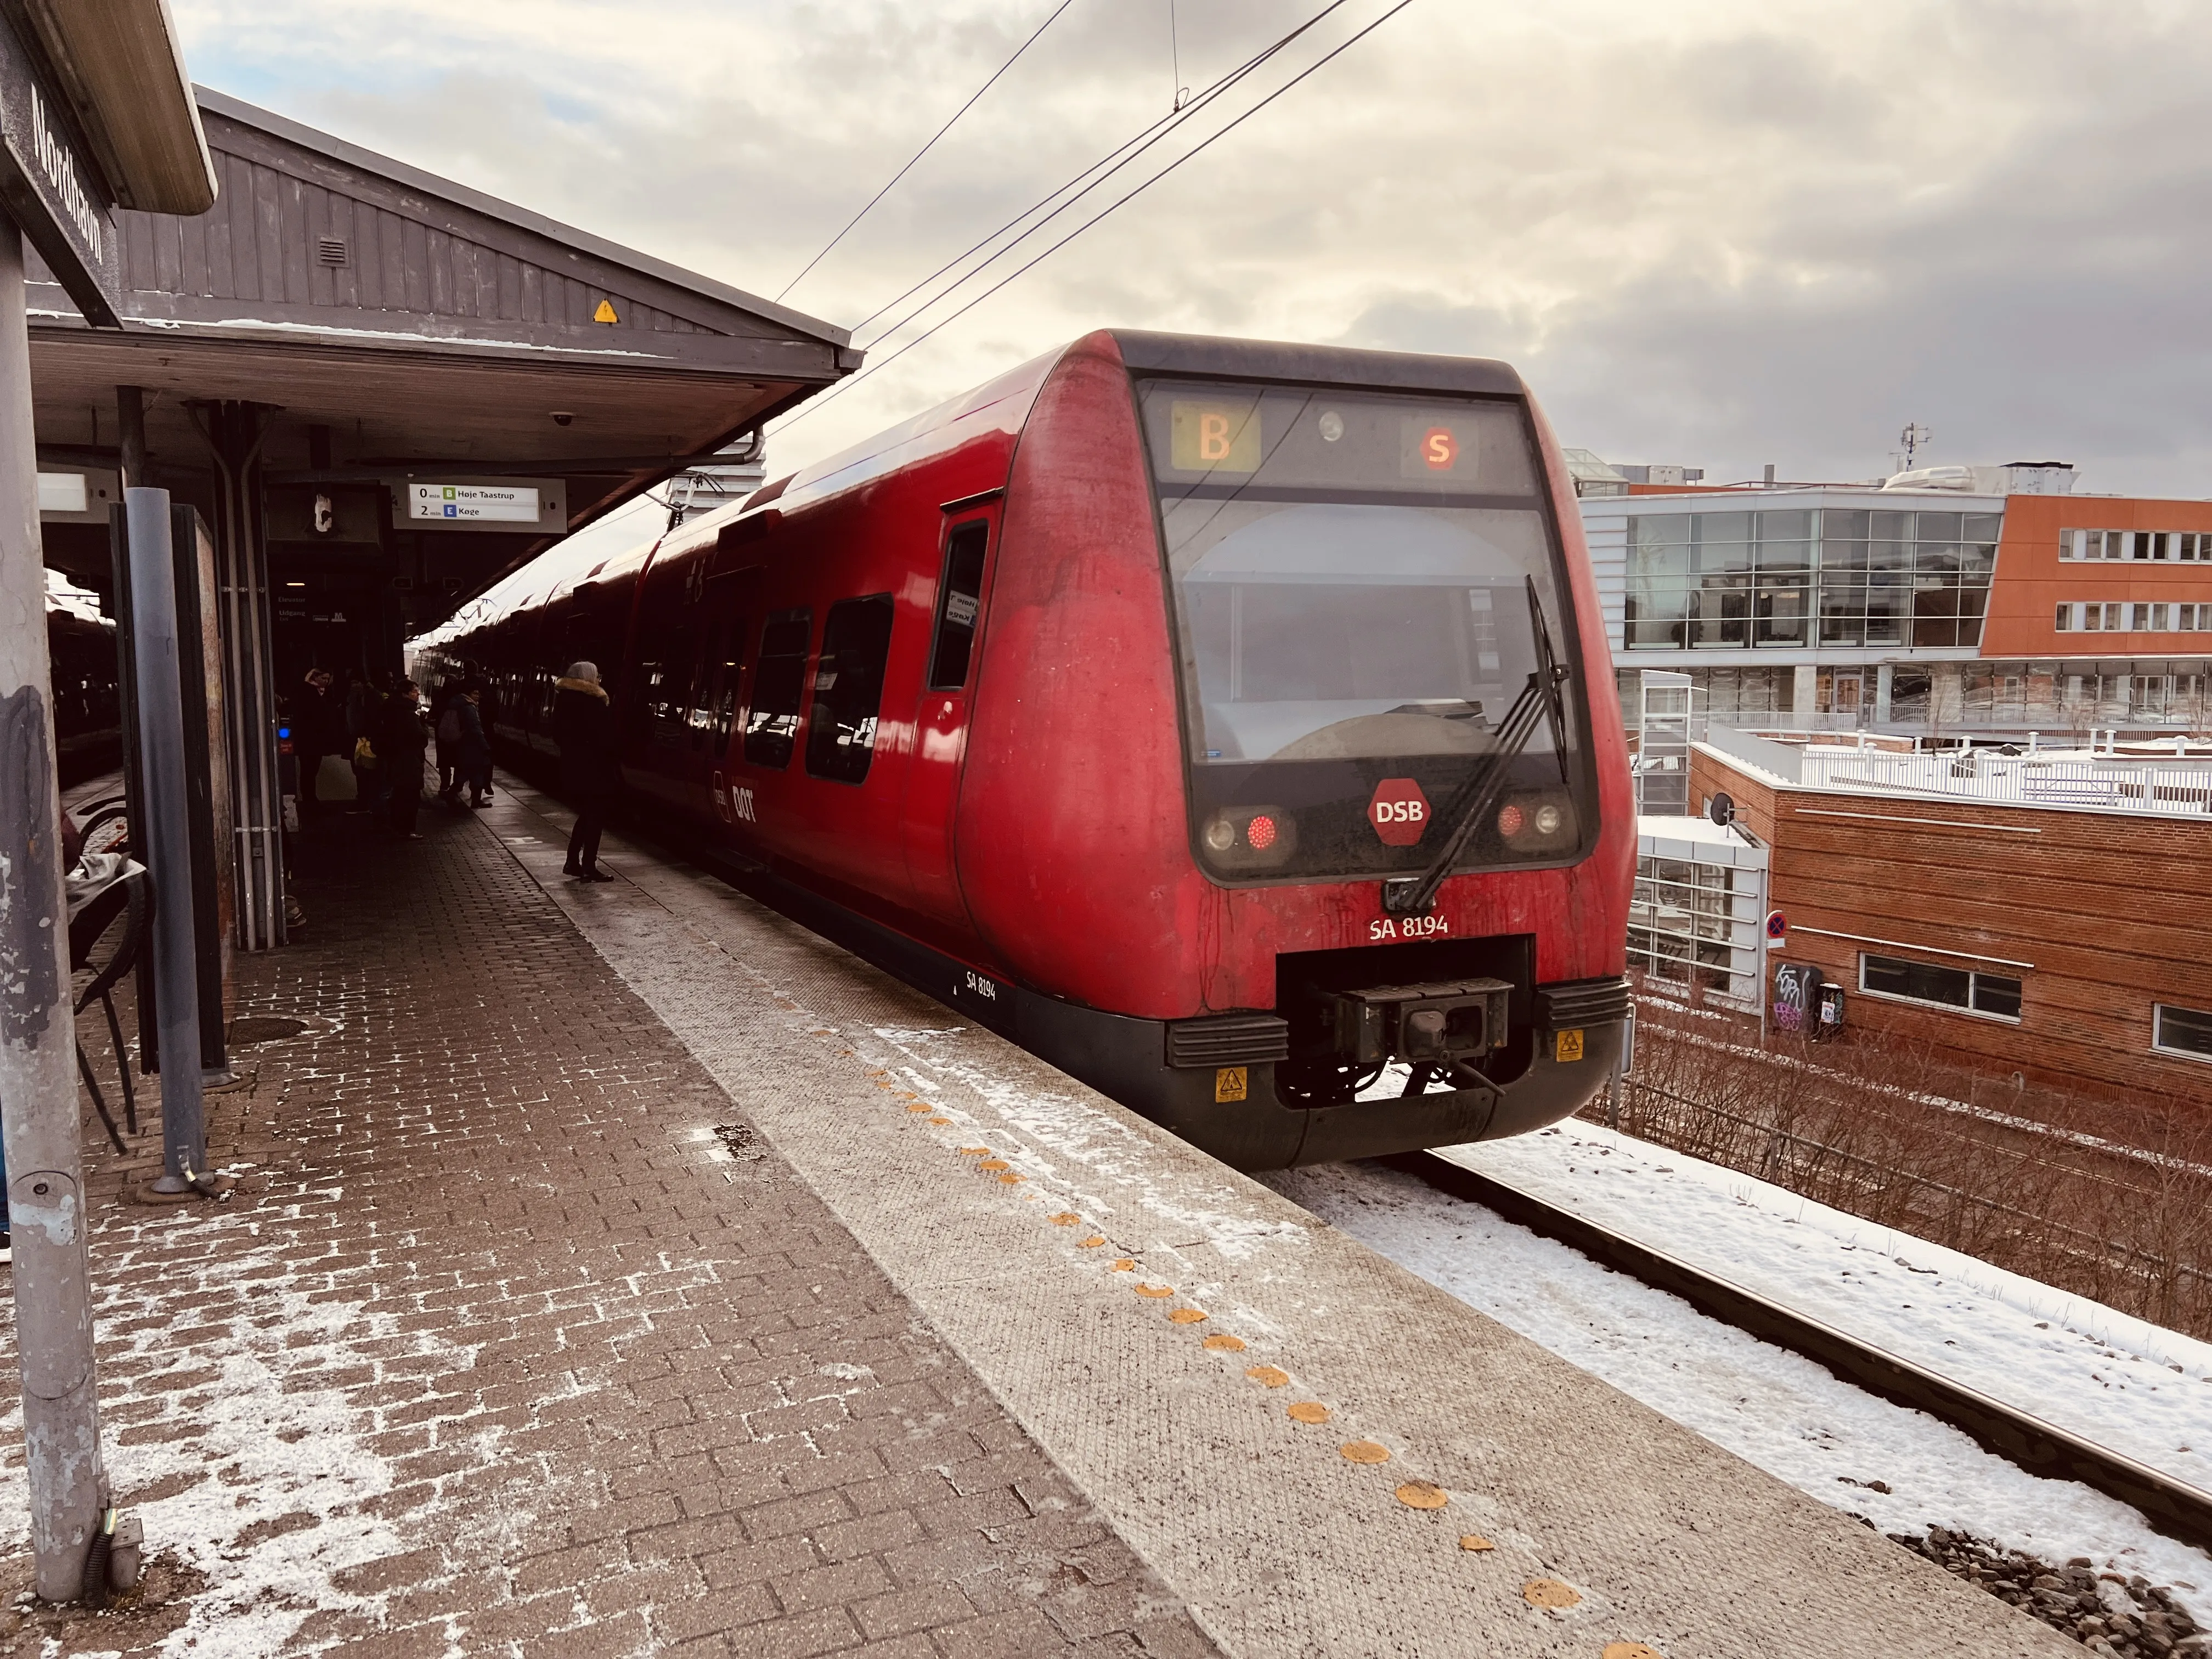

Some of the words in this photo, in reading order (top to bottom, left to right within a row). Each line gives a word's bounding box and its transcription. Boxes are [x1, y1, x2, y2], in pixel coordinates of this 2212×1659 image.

[31, 82, 102, 266] Nordhavn
[1200, 414, 1229, 459] B
[1429, 435, 1449, 462] S
[420, 488, 427, 498] 0
[446, 489, 453, 498] B
[479, 492, 515, 500] Taastrup
[421, 506, 428, 516] 2
[732, 785, 756, 823] DOT
[1376, 801, 1423, 823] DSB
[1369, 919, 1397, 940] SA
[1402, 915, 1448, 937] 8194
[967, 971, 977, 991] SA
[978, 977, 995, 1001] 8194
